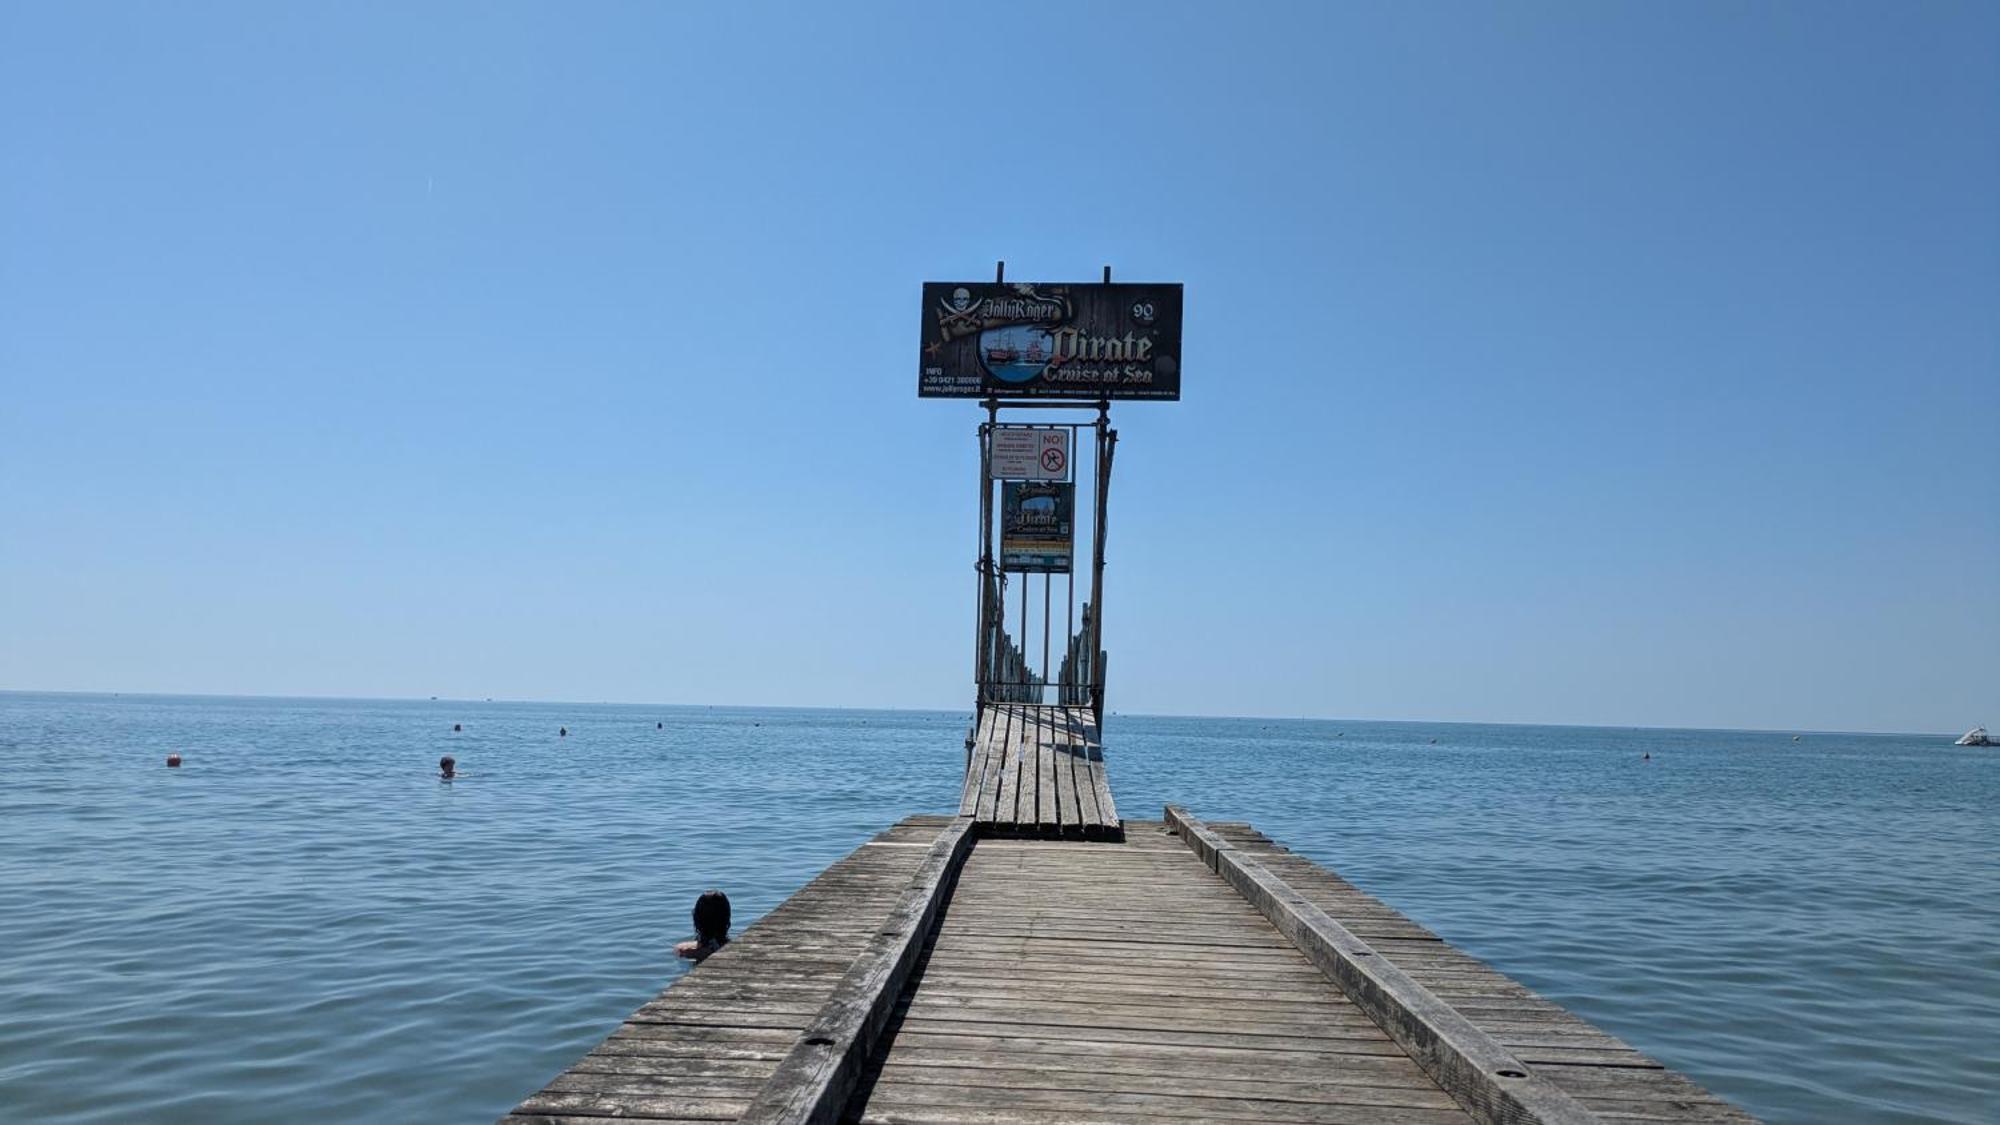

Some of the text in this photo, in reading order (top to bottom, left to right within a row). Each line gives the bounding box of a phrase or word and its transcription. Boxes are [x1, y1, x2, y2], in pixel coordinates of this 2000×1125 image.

[1133, 303, 1153, 318] 90
[1052, 328, 1153, 365] Pirate
[926, 367, 942, 376] INFO
[1043, 364, 1153, 385] Cruise at Sea
[1043, 434, 1065, 446] NO!
